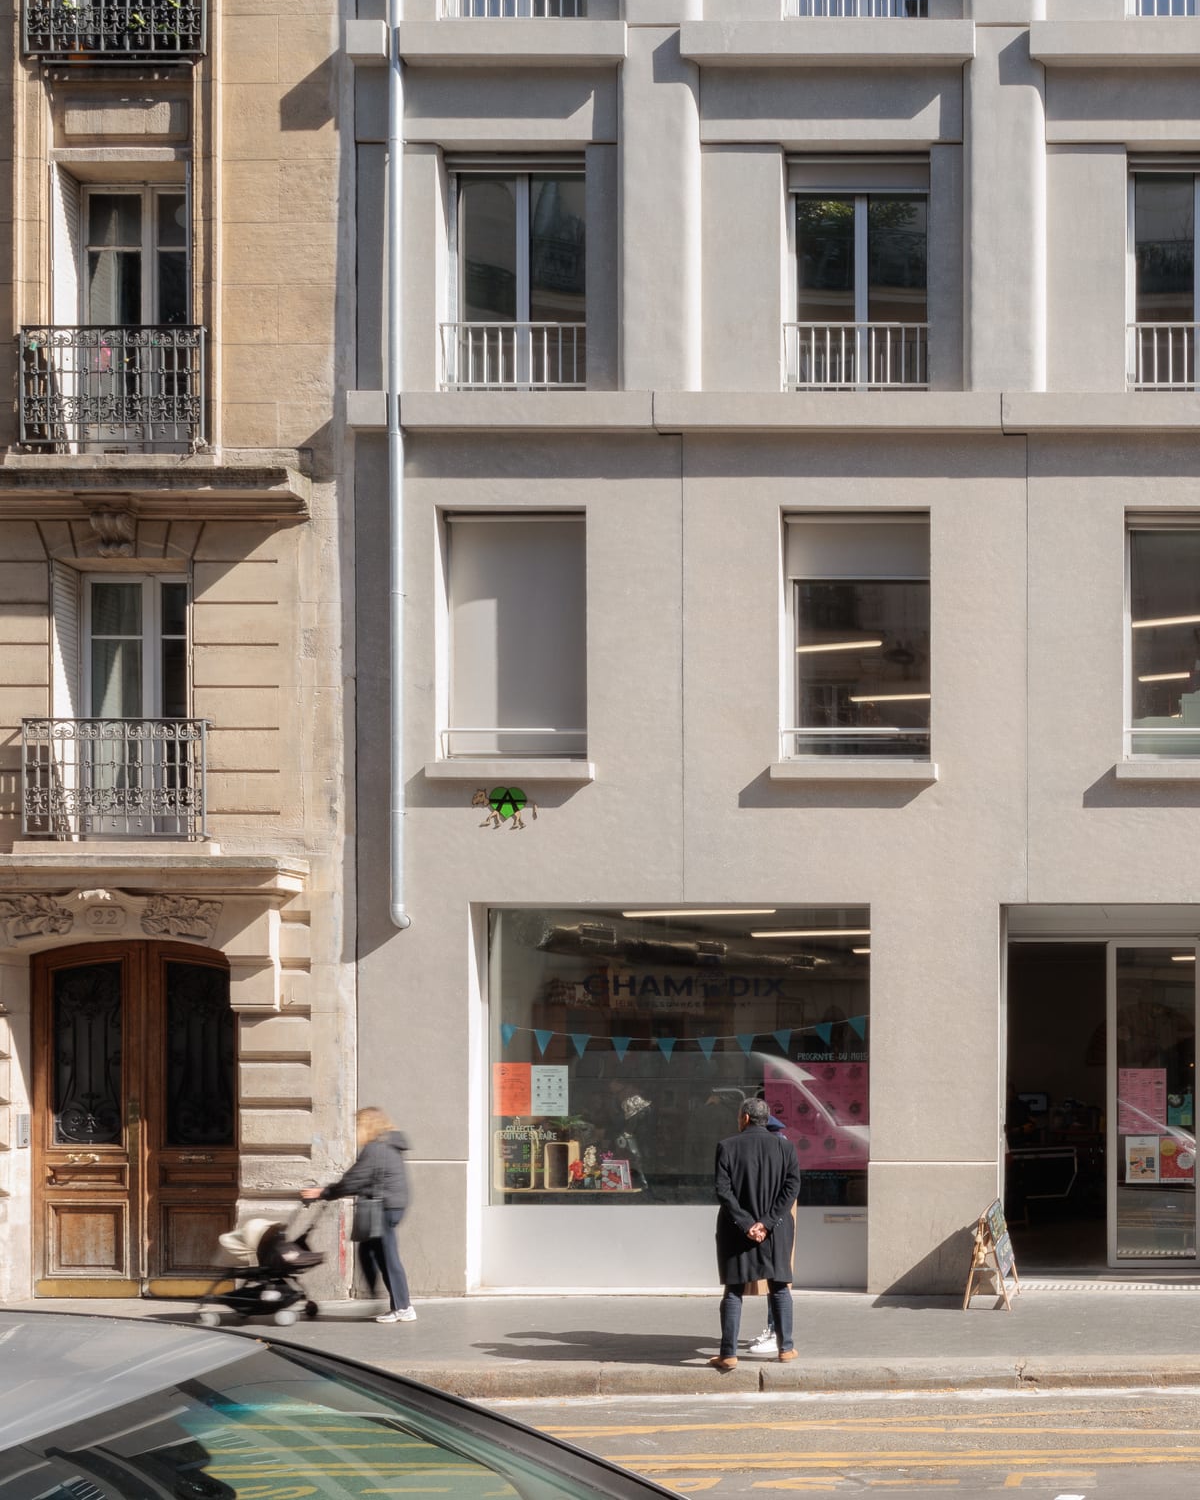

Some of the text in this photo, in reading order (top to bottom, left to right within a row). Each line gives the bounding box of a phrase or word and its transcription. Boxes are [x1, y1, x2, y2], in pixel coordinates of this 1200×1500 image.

[92, 910, 117, 925] 22
[583, 974, 785, 997] CHAM DIX
